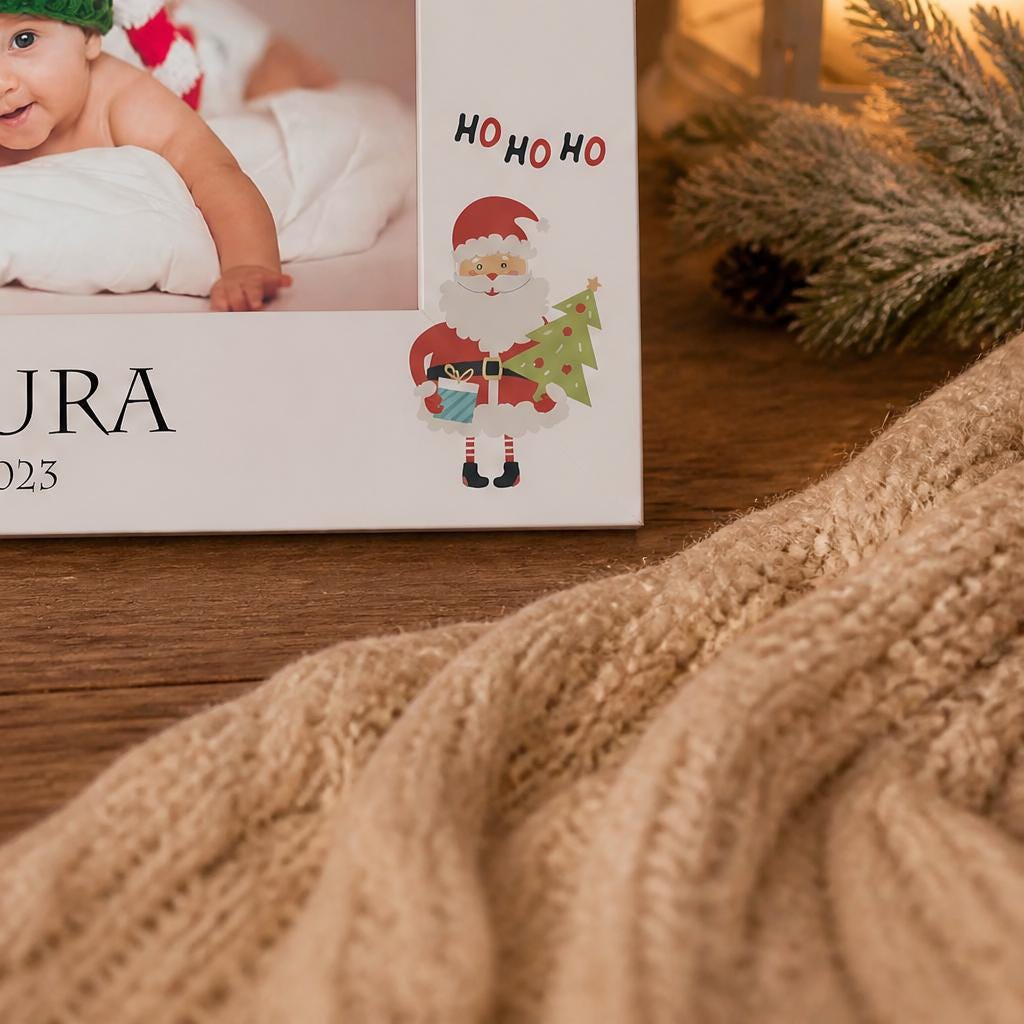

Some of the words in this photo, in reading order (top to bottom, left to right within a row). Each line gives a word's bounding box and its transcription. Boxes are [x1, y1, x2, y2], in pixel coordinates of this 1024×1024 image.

[454, 112, 502, 148] HO
[503, 134, 552, 169] HO
[559, 131, 607, 167] HO
